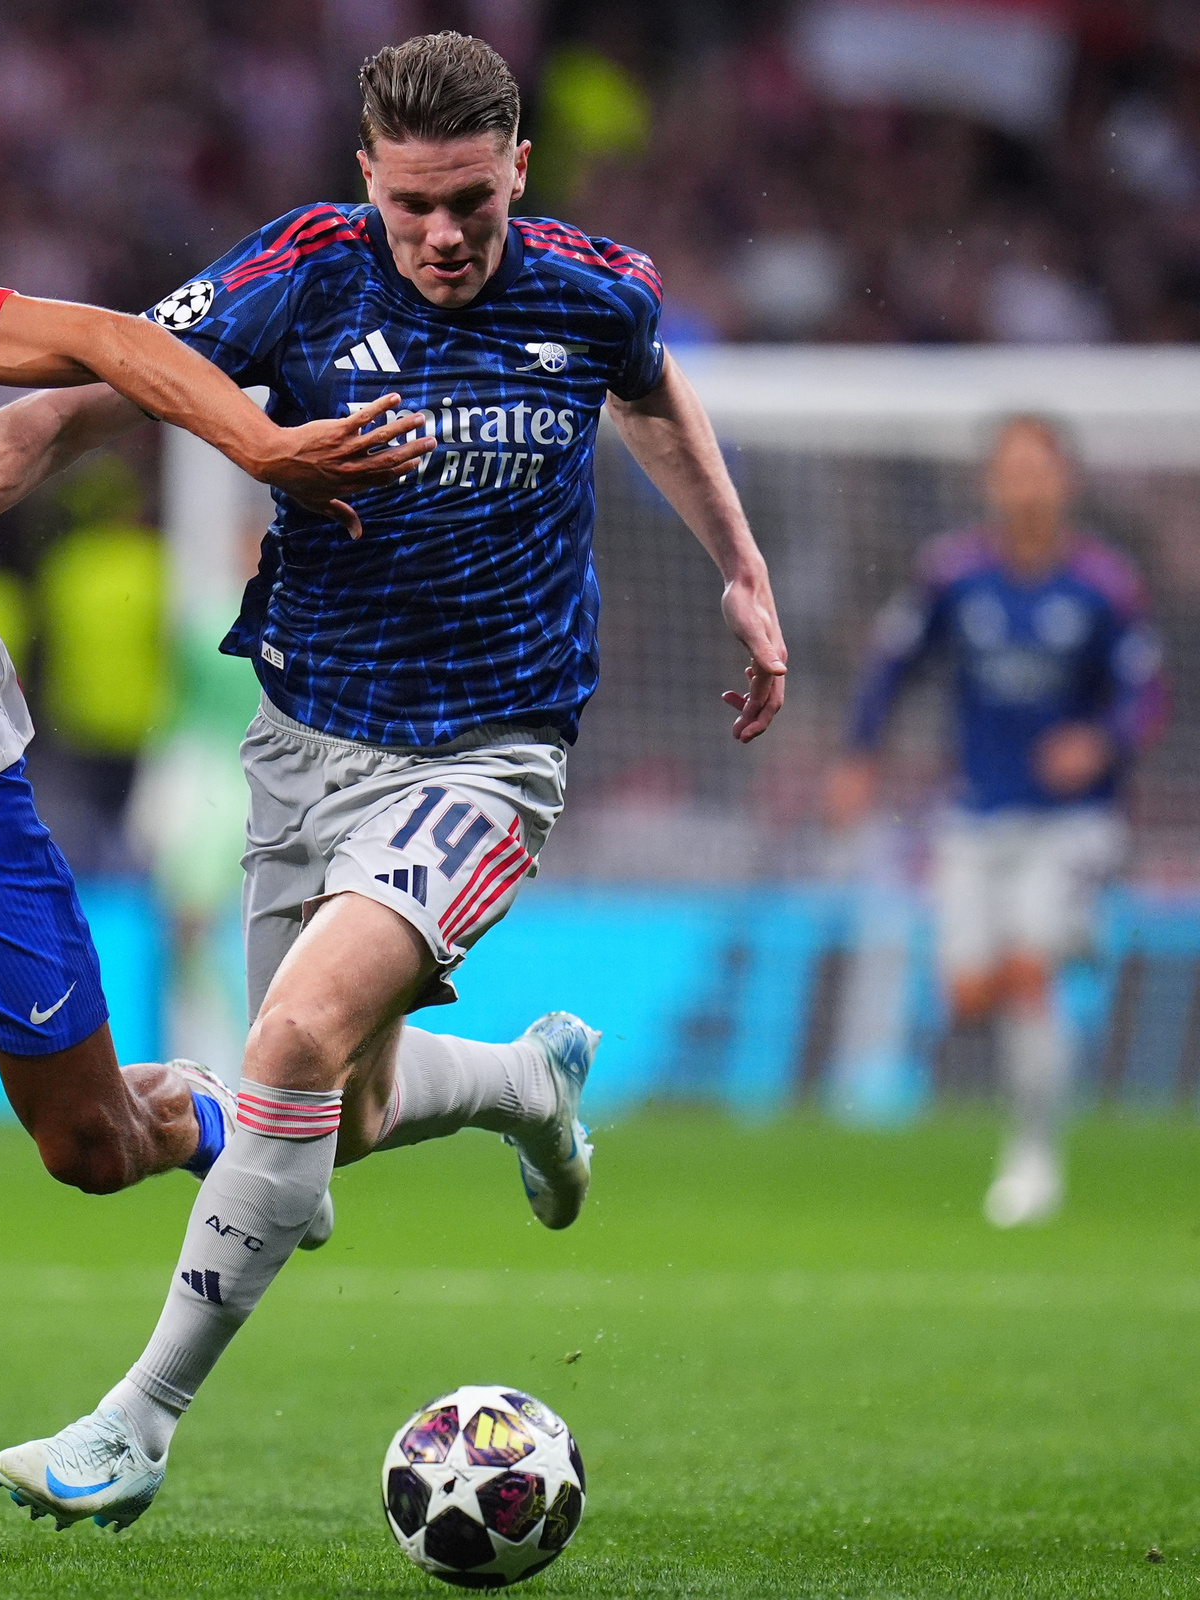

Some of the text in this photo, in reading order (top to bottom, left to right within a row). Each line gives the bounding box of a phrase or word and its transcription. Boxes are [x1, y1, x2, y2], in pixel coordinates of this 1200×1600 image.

[439, 451, 546, 490] BETTER
[387, 784, 495, 881] 14
[205, 1214, 264, 1252] AFC
